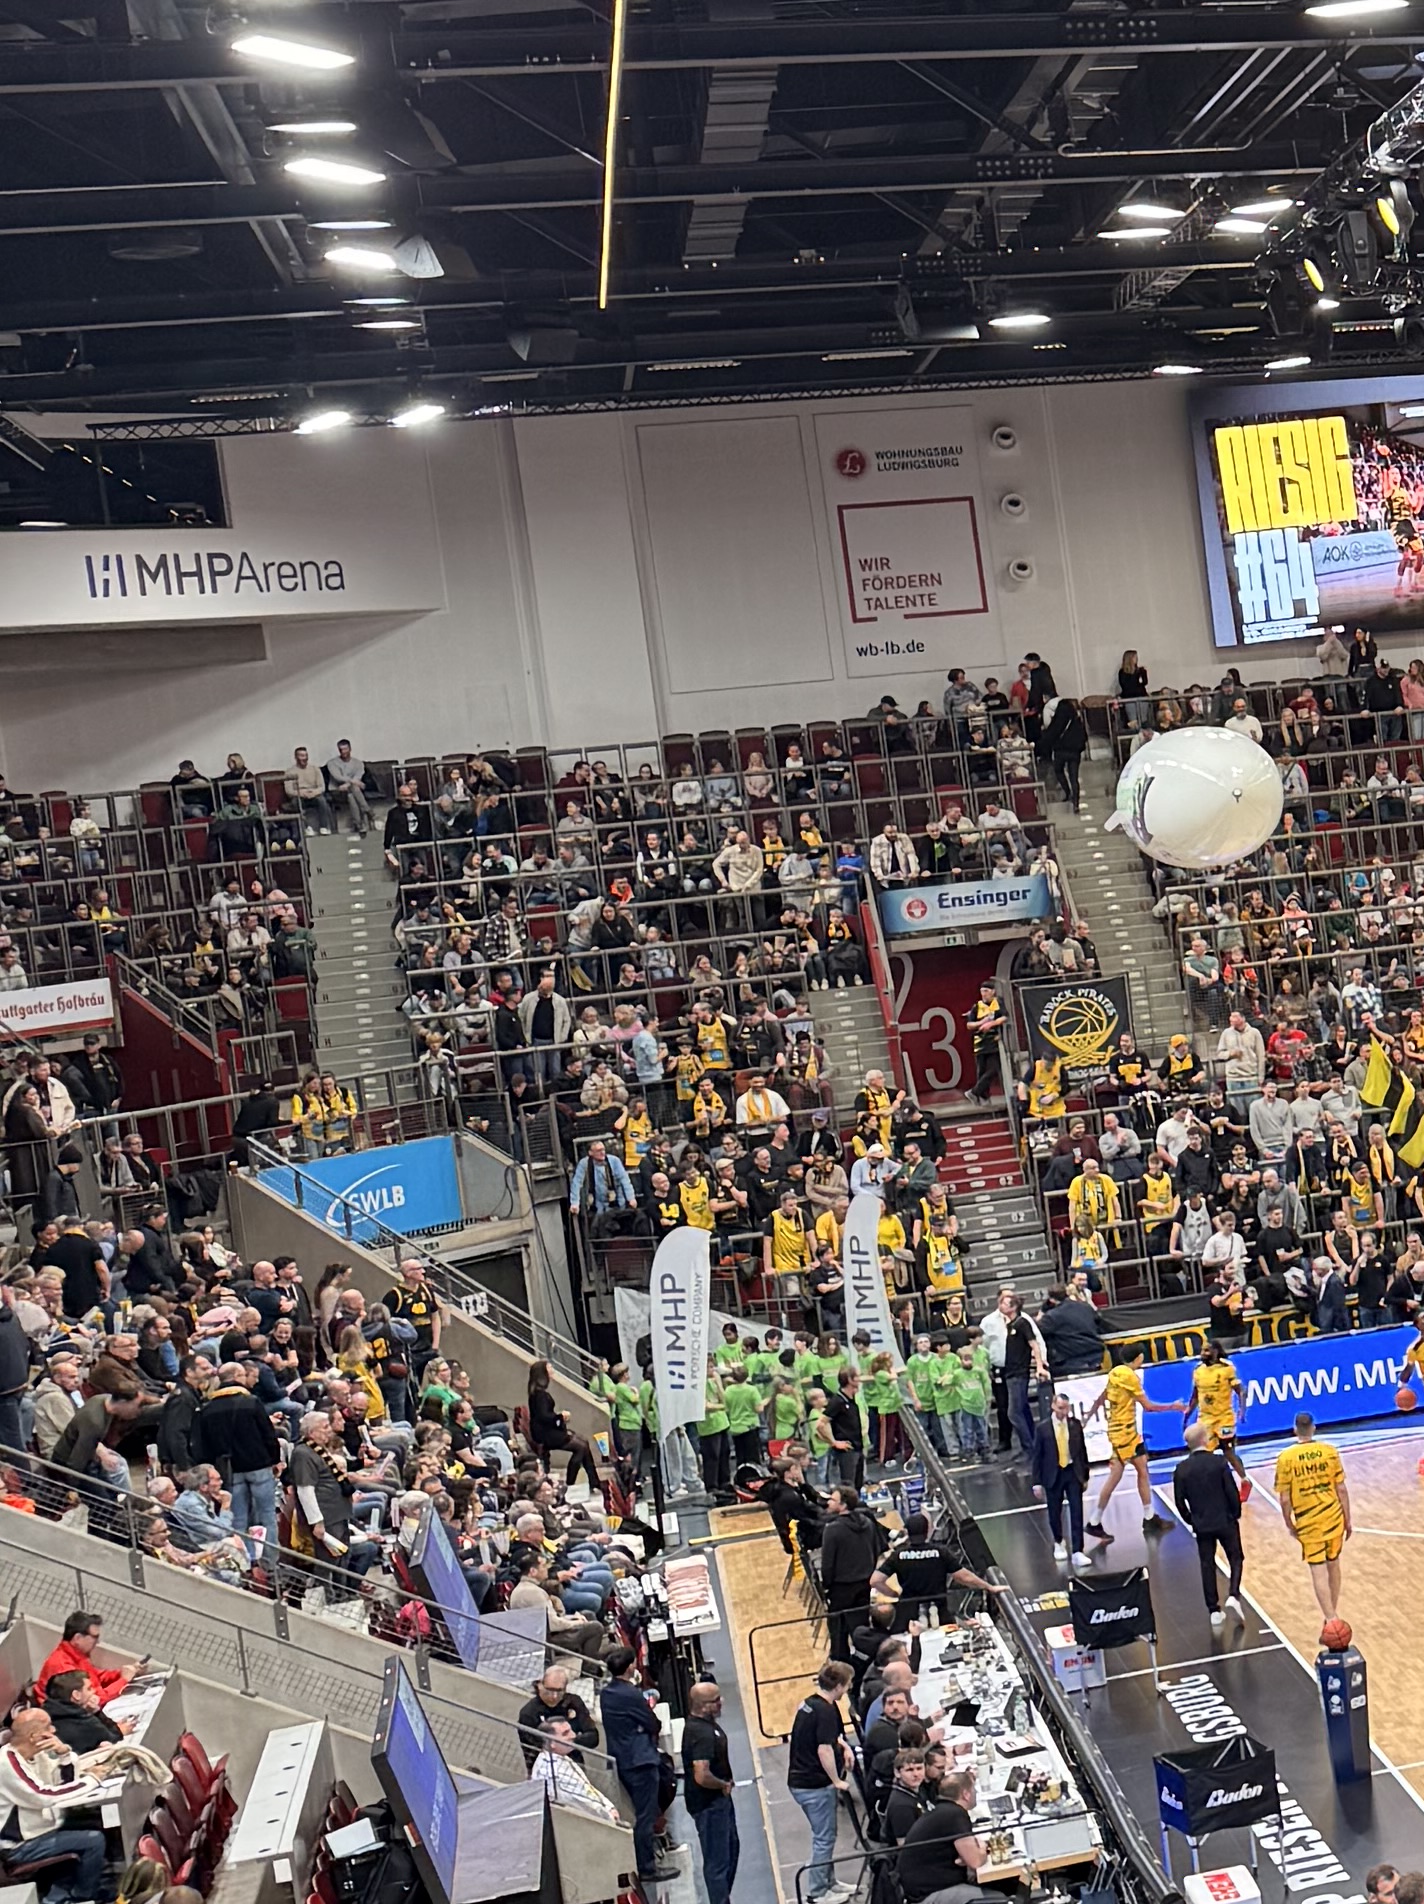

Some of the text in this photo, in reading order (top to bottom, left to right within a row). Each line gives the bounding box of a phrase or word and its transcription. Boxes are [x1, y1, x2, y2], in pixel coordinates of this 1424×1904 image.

[874, 445, 964, 461] WOHNUNGSBAU
[876, 457, 960, 473] LUDWIGSBURG
[1214, 416, 1358, 534] RIESIG
[858, 557, 892, 573] WIR
[1322, 545, 1350, 565] AOK
[134, 551, 346, 597] MHPArena
[861, 572, 943, 592] FÖRDERN
[1233, 527, 1321, 624] #64
[864, 593, 939, 612] TALENTE
[856, 639, 926, 658] wb-lb.de
[937, 887, 1032, 910] Ensinger
[56, 992, 105, 1014] Hofbräu
[1039, 987, 1118, 1025] BAROCK PIRATES
[849, 1234, 880, 1310] MHP
[660, 1272, 687, 1351] MHP
[899, 1548, 940, 1561] macron
[1089, 1605, 1140, 1625] Baden
[1205, 1782, 1264, 1809] Baden
